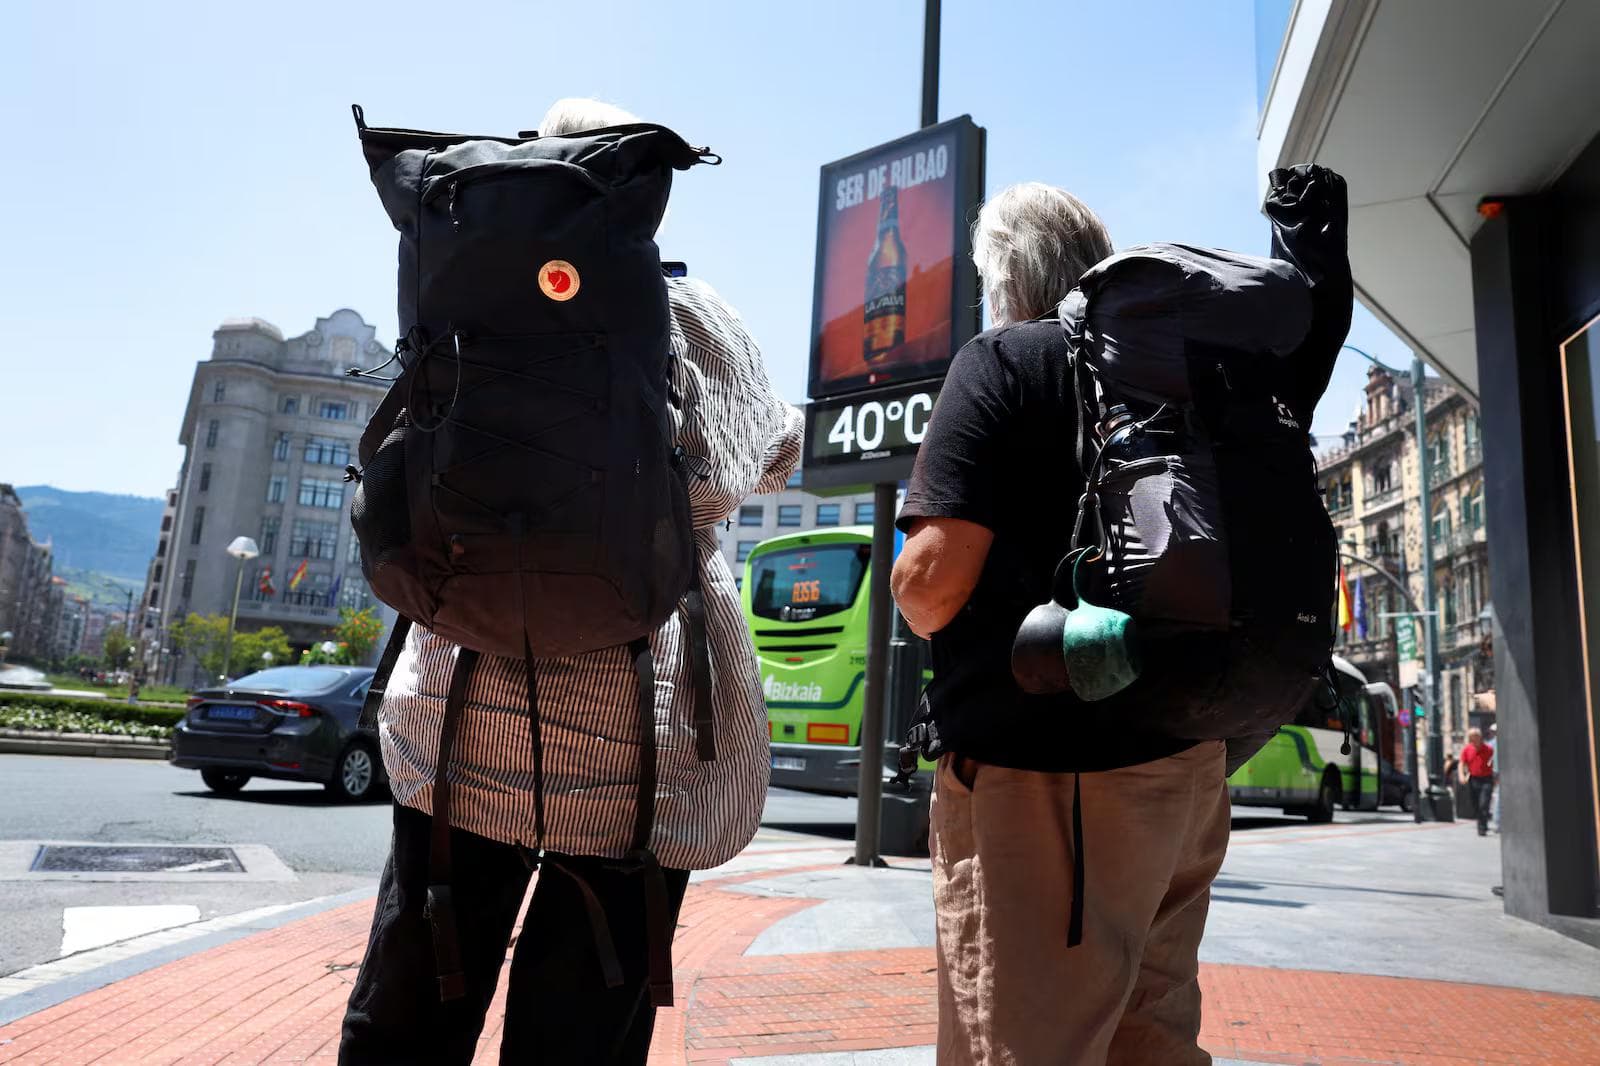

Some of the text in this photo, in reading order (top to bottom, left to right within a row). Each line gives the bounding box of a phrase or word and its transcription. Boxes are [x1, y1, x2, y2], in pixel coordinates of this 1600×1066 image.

[836, 145, 948, 211] SER DE BILBAO
[828, 393, 932, 453] 40°C
[772, 681, 822, 701] Bizkaia
